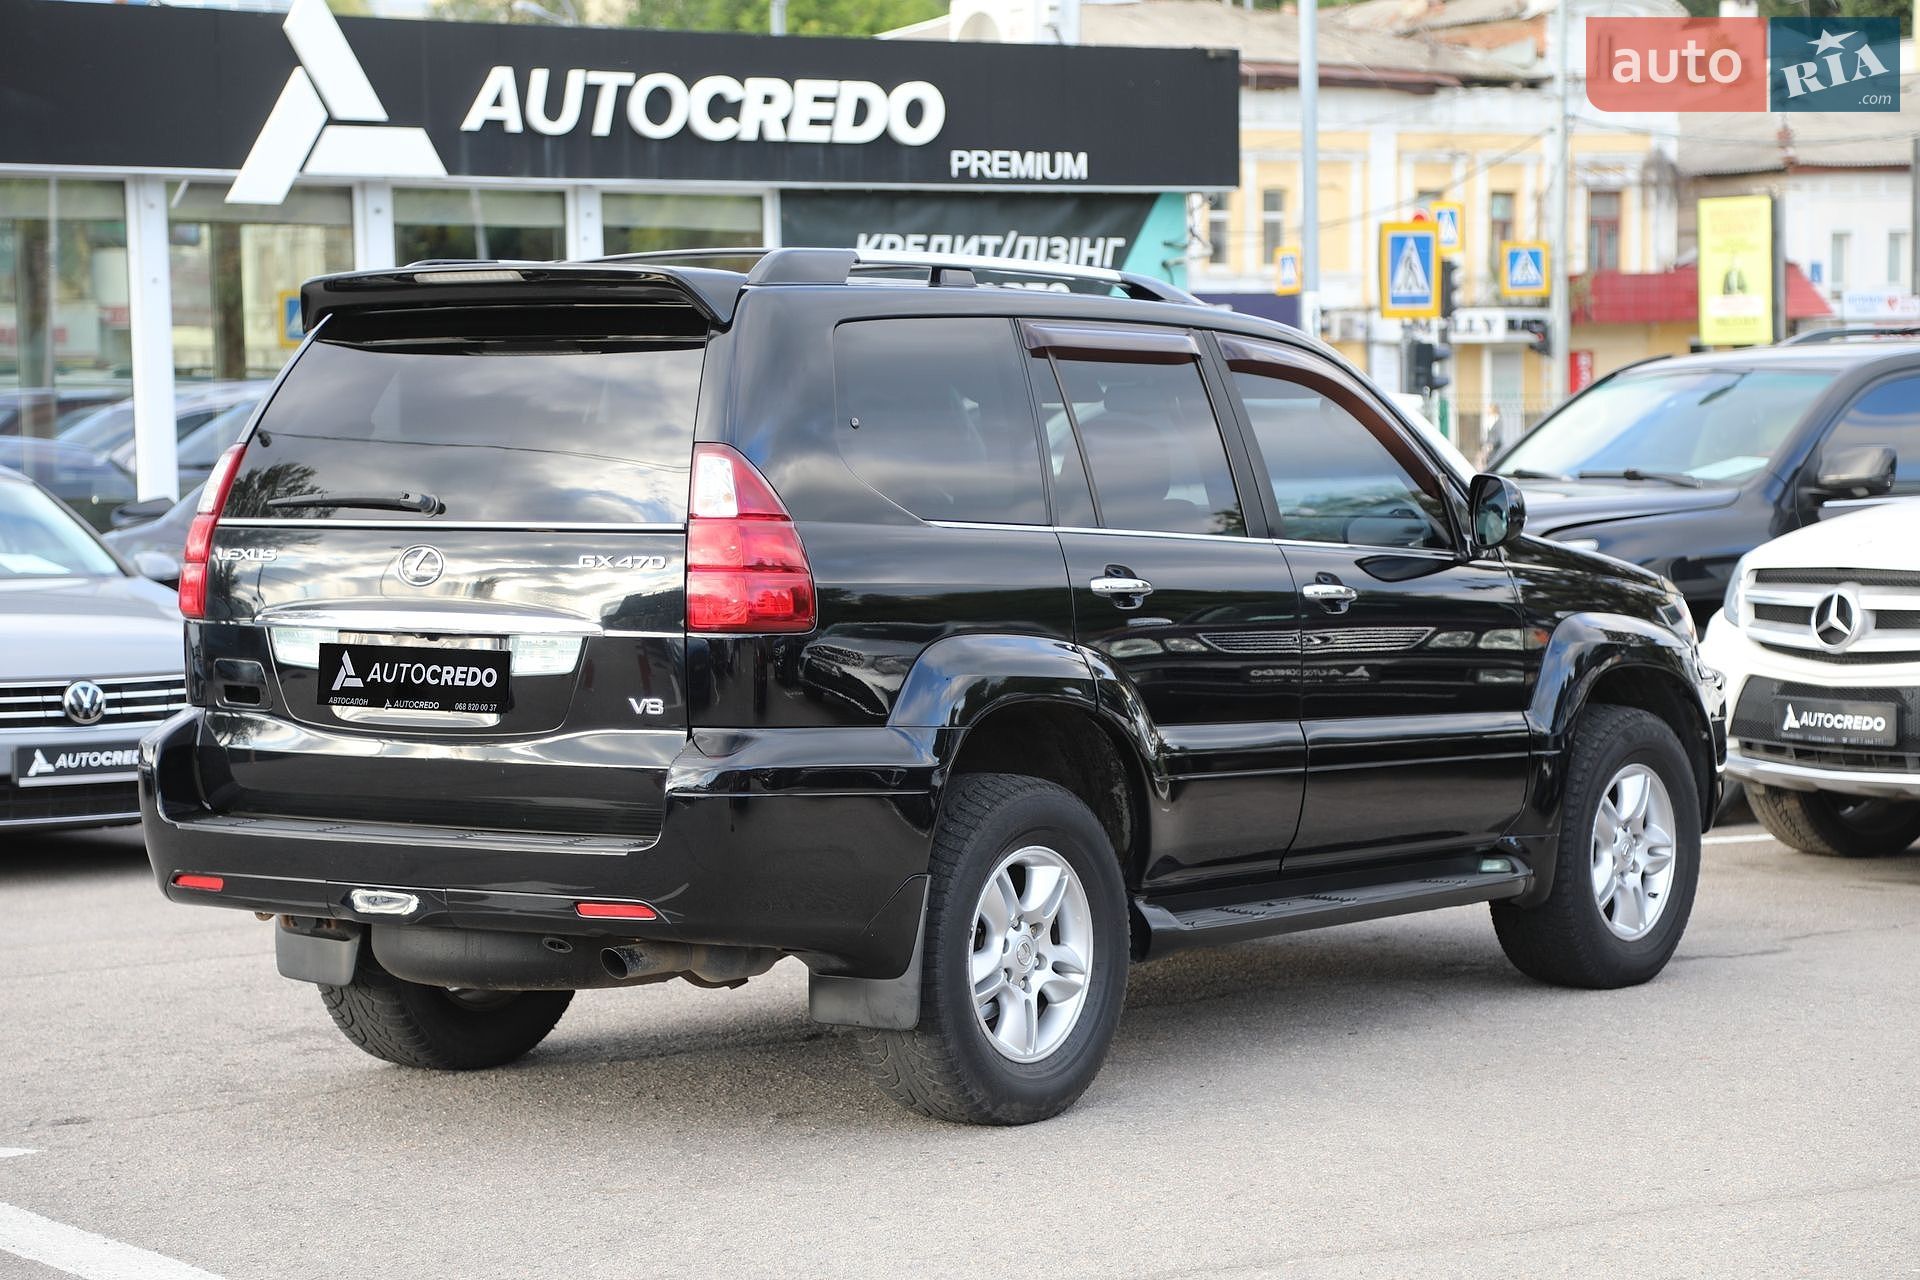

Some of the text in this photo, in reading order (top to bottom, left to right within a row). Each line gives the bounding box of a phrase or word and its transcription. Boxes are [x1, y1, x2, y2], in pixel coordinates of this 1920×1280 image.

[460, 65, 946, 147] AUTOCREDO
[950, 150, 1088, 181] PREMIUM
[216, 547, 277, 562] LEXUS
[579, 554, 666, 569] GX 470
[366, 661, 498, 689] AUTOCREDO
[328, 696, 369, 706] АВТОСАЛОН
[393, 700, 440, 710] AUTOCREDO
[454, 703, 497, 712] 068 820 00 37
[628, 697, 664, 715] V8
[1800, 711, 1886, 732] AUTOCREDO
